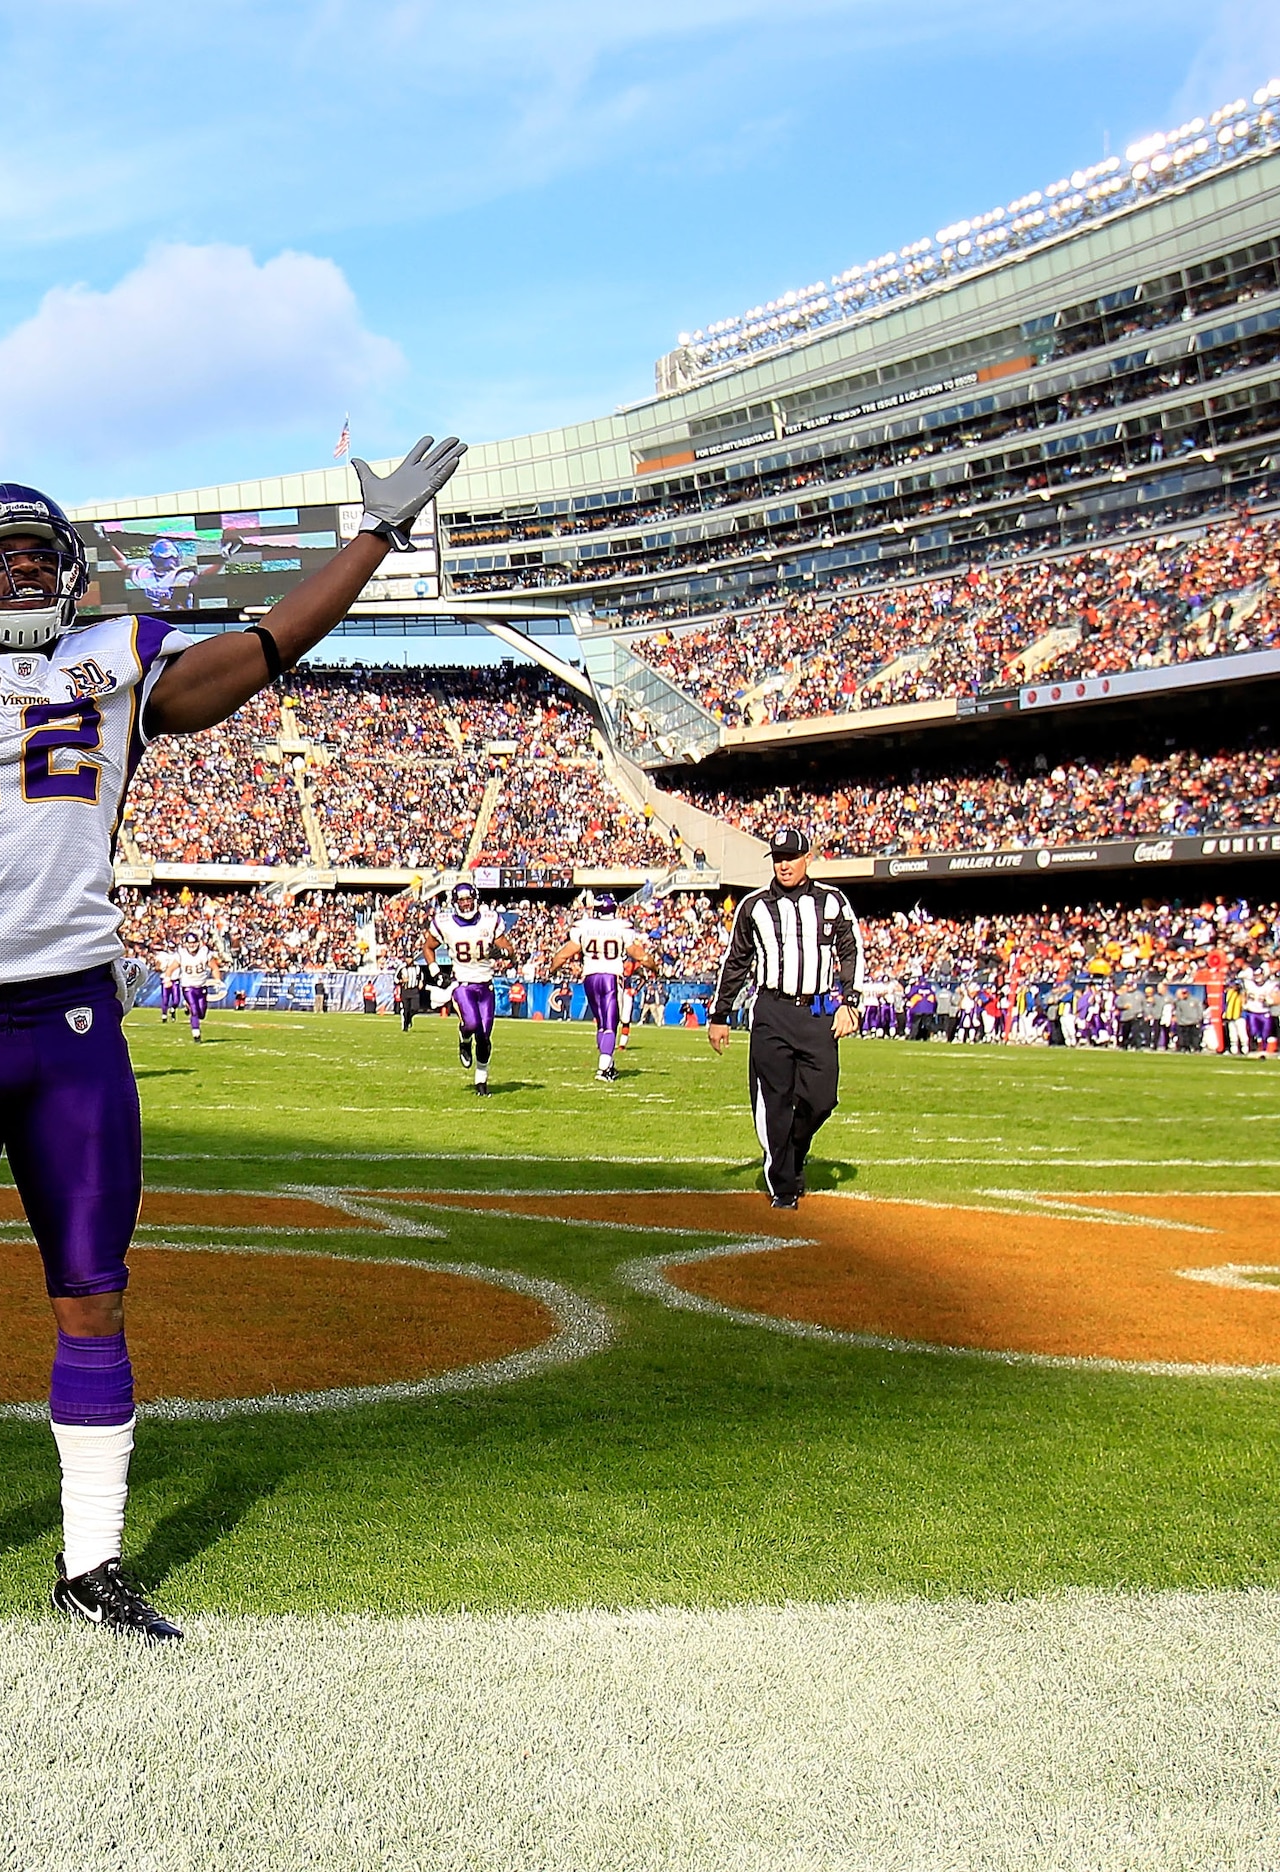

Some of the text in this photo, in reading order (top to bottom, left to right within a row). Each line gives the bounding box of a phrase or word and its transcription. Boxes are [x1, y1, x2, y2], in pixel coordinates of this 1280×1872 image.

[359, 582, 410, 598] HASE
[949, 854, 1023, 870] MILLER LITE
[455, 940, 485, 963] 81
[585, 939, 619, 960] 40
